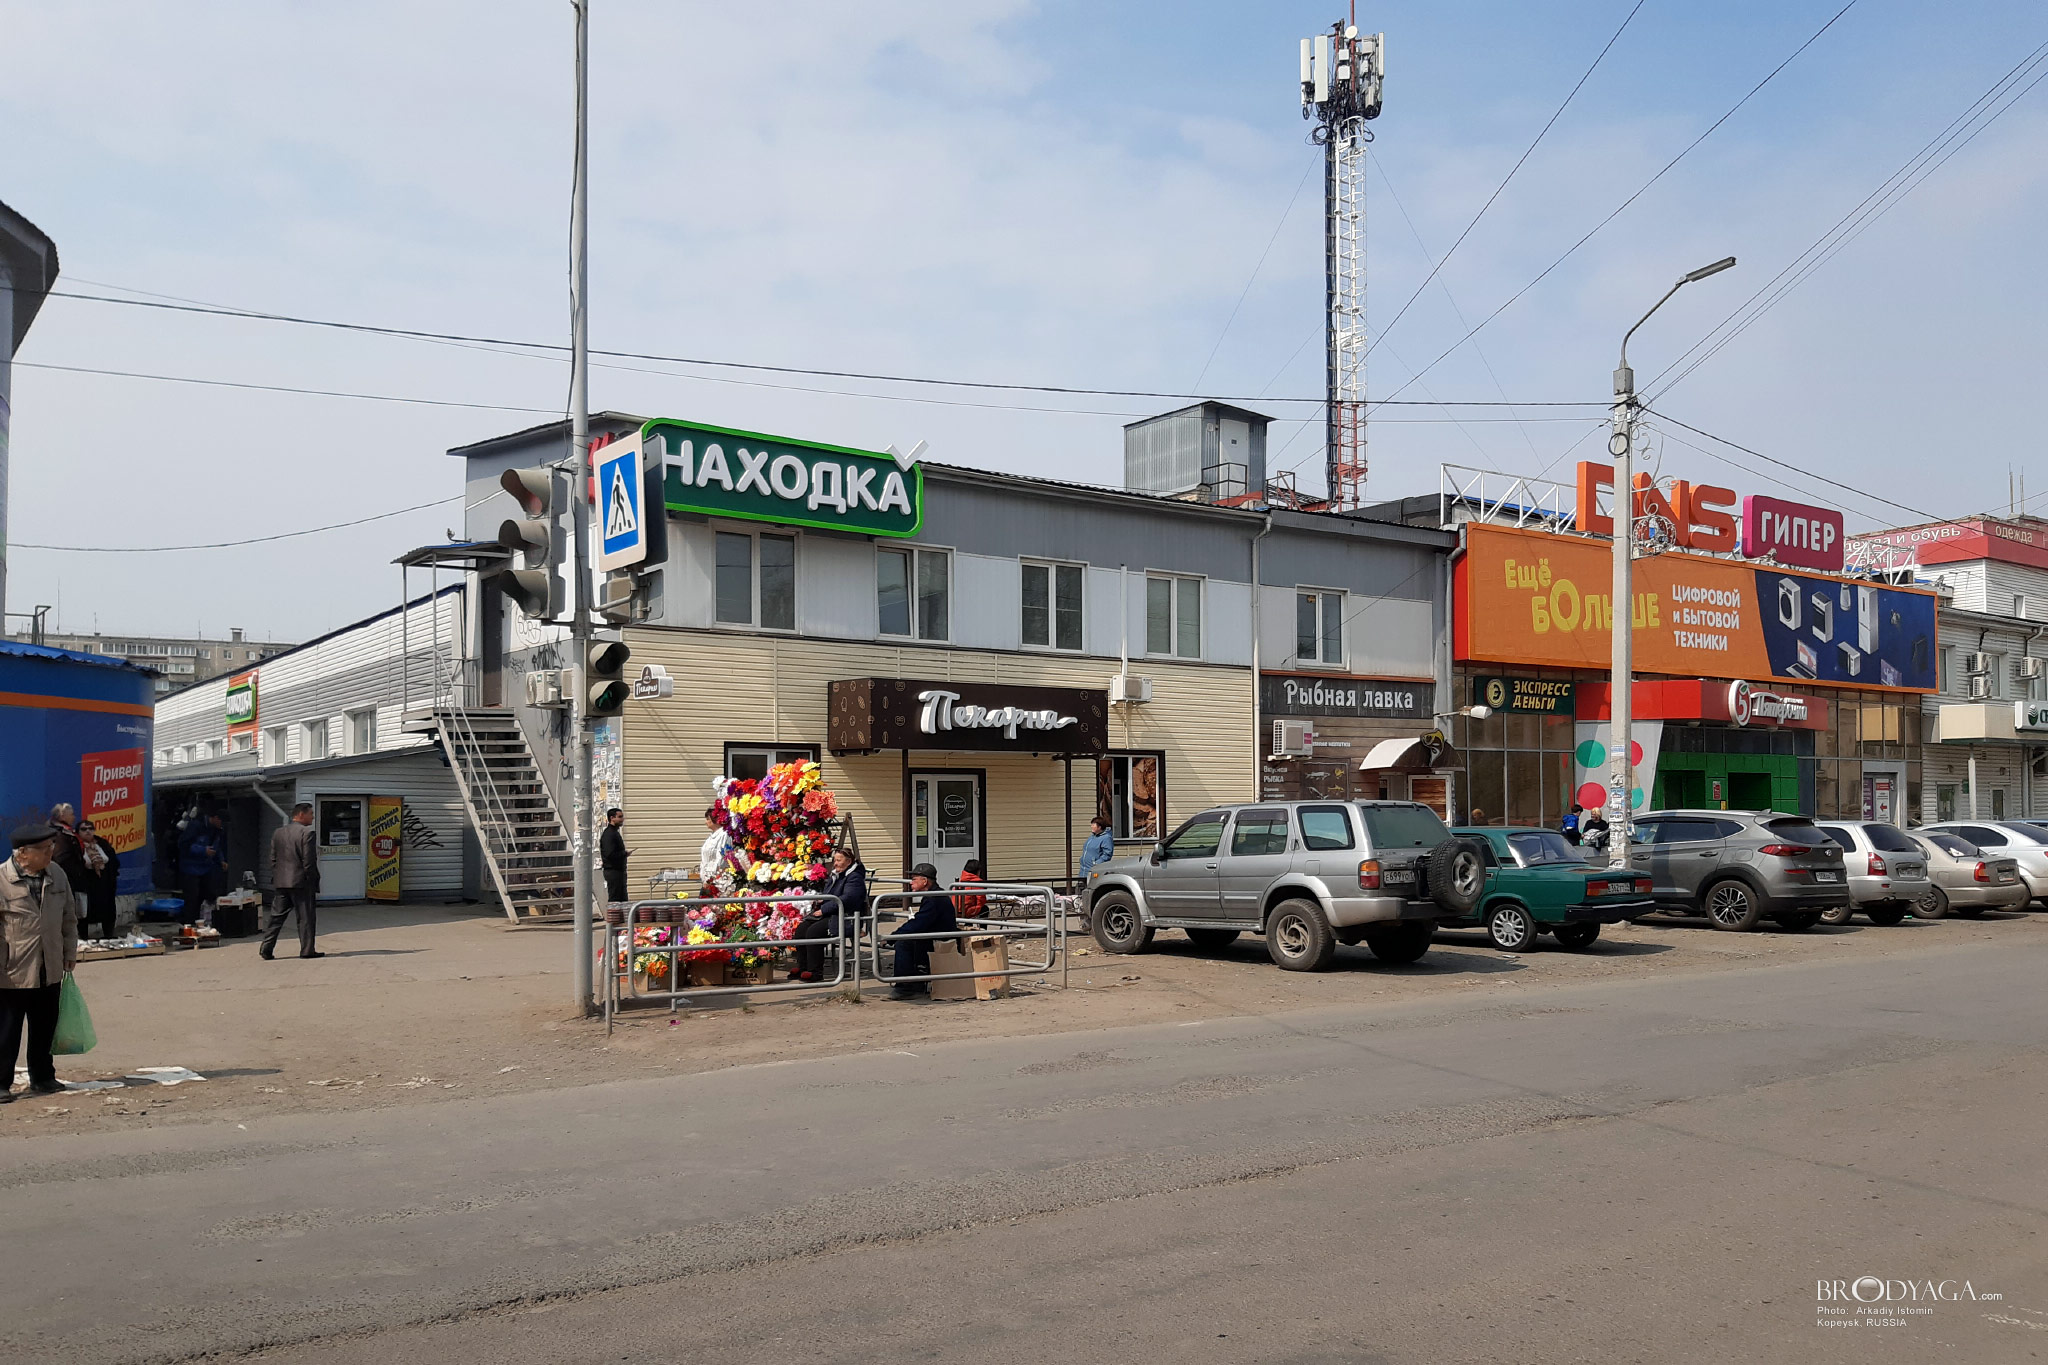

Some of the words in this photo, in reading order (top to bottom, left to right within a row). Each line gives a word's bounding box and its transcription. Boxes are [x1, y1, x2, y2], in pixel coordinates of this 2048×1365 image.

[661, 436, 911, 515] НАХОДКА
[1576, 461, 1737, 552] DNS
[1762, 511, 1836, 553] ГИПЕР
[1896, 534, 1905, 544] и
[1911, 527, 1961, 545] обувь
[1995, 525, 2034, 544] одежда
[1505, 558, 1552, 592] Ещё
[1672, 584, 1741, 608] ЦИФРОВОЙ
[1673, 610, 1680, 623] и
[1683, 608, 1739, 630] БЫТОВОЙ
[1673, 630, 1728, 651] ТЕХНИКИ
[1283, 679, 1356, 707] Рыбная
[1363, 690, 1414, 708] лавка
[1513, 680, 1571, 697] ЭКСПРЕСС
[1512, 694, 1556, 710] ДЕНЬГИ
[918, 690, 1078, 740] Пекарня
[93, 763, 142, 786] Приведи
[92, 786, 128, 808] друга
[94, 812, 134, 831] получи
[370, 815, 400, 837] ОПТИКА
[380, 839, 393, 850] 100
[369, 866, 398, 888] ОПТИКА
